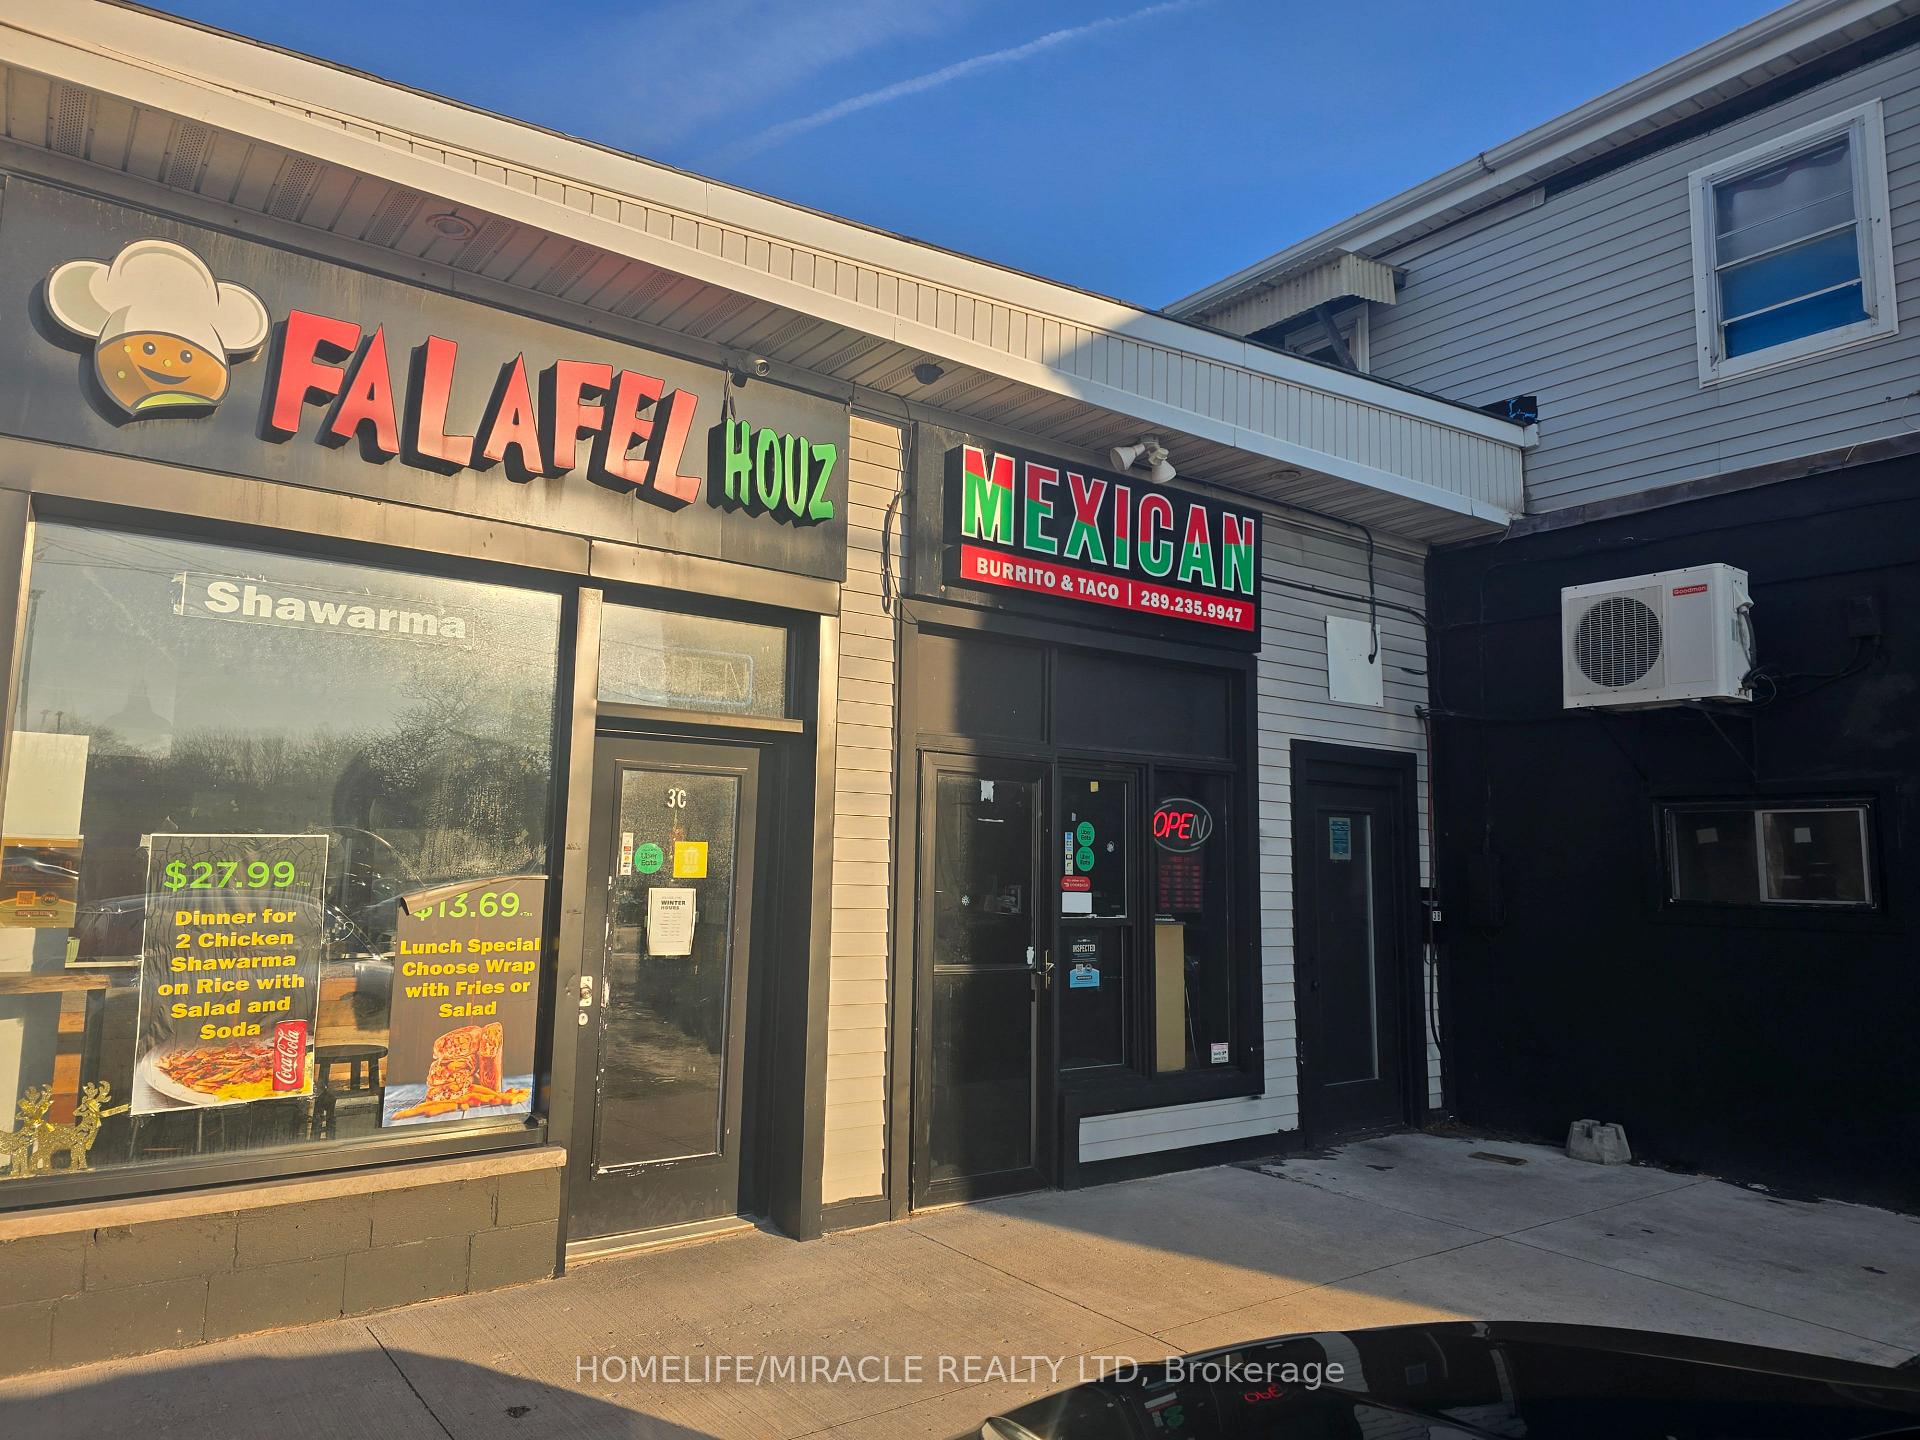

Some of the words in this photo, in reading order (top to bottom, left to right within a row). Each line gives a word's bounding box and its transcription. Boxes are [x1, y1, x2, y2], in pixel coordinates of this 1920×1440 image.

[271, 308, 702, 504] FALAFEL
[724, 418, 838, 520] HOUZ
[960, 444, 1255, 596] MEXICAN
[976, 556, 1056, 588] BURRITO
[1062, 574, 1074, 592] &
[1078, 577, 1119, 600] TACO
[1140, 590, 1243, 623] 289.235.9947
[203, 581, 466, 639] Shawarma
[1153, 811, 1207, 839] OPEN
[164, 860, 295, 892] $27.99
[175, 911, 256, 926] Dinner
[262, 908, 296, 923] for
[176, 934, 191, 949] 2
[198, 931, 294, 948] Chicken
[400, 939, 462, 955] Lunch
[467, 937, 541, 957] Special
[171, 955, 296, 973] Shawarma
[402, 961, 480, 977] Choose
[486, 959, 536, 976] Wrap
[158, 982, 189, 997] on
[196, 978, 250, 995] Rice
[256, 974, 305, 991] with
[405, 981, 450, 998] with
[455, 980, 505, 996] Fries
[509, 980, 531, 994] or
[171, 1000, 241, 1019] Salad
[247, 996, 291, 1013] and
[438, 1001, 498, 1018] Salad
[199, 1021, 261, 1040] Soda
